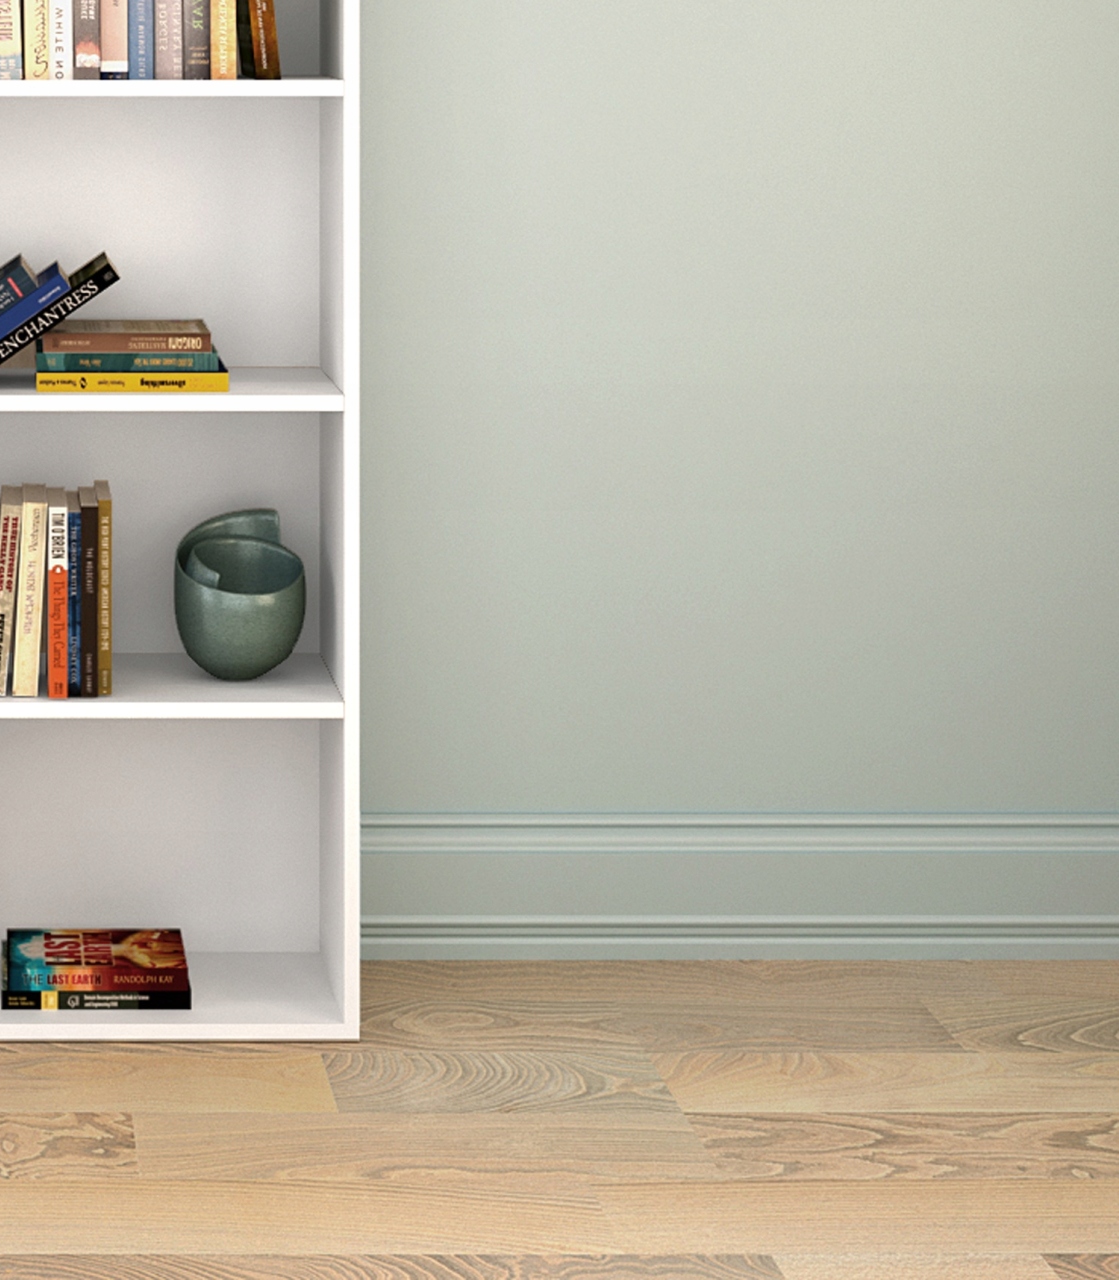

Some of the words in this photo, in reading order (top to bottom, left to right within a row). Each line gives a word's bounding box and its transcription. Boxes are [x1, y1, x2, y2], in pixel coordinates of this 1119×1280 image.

[167, 336, 202, 349] ORIGAMI
[140, 378, 186, 389] silversmithing
[9, 516, 19, 541] TRUE
[51, 513, 65, 526] TIM
[70, 526, 78, 541] THE
[51, 528, 65, 560] O'BRIEN
[7, 541, 17, 579] HISTORY
[70, 542, 78, 567] GHOST
[5, 579, 13, 592] OF
[53, 581, 64, 596] The
[70, 568, 78, 596] WRITER
[49, 596, 65, 621] Things
[44, 932, 82, 966] LAST
[22, 973, 44, 985] THE
[47, 973, 69, 985] LAST
[71, 973, 101, 985] EARTH
[113, 975, 157, 984] RANDOLPH
[158, 975, 174, 984] KAY
